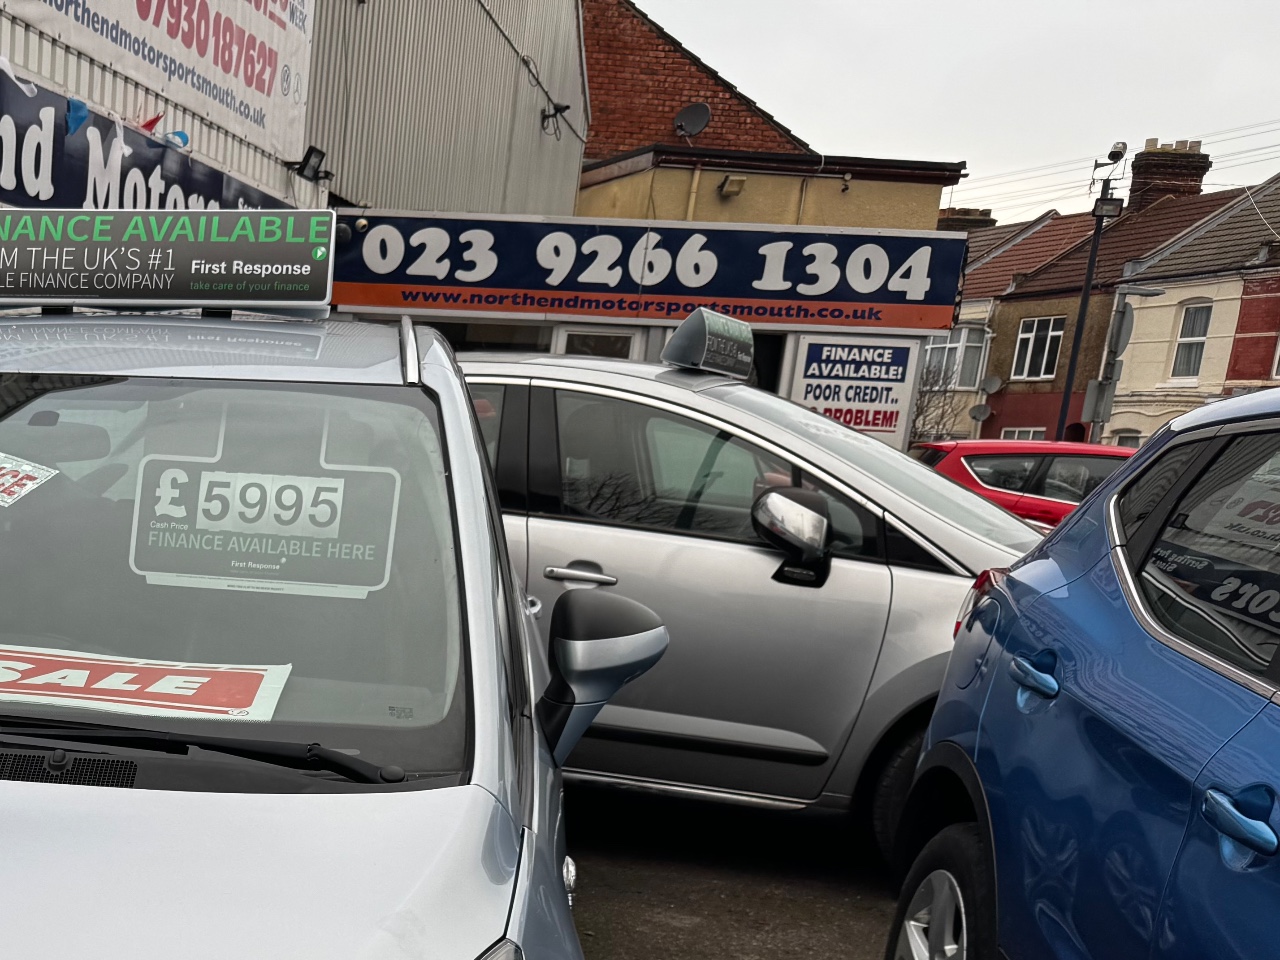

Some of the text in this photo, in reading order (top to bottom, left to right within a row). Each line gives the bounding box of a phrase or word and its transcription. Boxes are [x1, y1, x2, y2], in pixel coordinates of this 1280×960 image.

[212, 11, 279, 98] 187627
[83, 126, 221, 210] Mot
[122, 215, 330, 243] AVAILABLE
[26, 247, 76, 270] THE
[83, 247, 142, 271] UK'S
[147, 248, 176, 271] #1
[362, 223, 931, 300] 023 9266 1304
[191, 260, 311, 278] First Response
[20, 272, 89, 289] FINANCE
[93, 273, 175, 290] COMPANY
[190, 281, 310, 293] take care of your finance
[821, 346, 893, 363] FINANCE
[806, 362, 903, 380] AVAILABLE!
[804, 383, 842, 402] POOR
[150, 521, 189, 531] Cash Price
[148, 531, 376, 561] FINANCE AVAILABLE HERE
[231, 560, 280, 570] First Response
